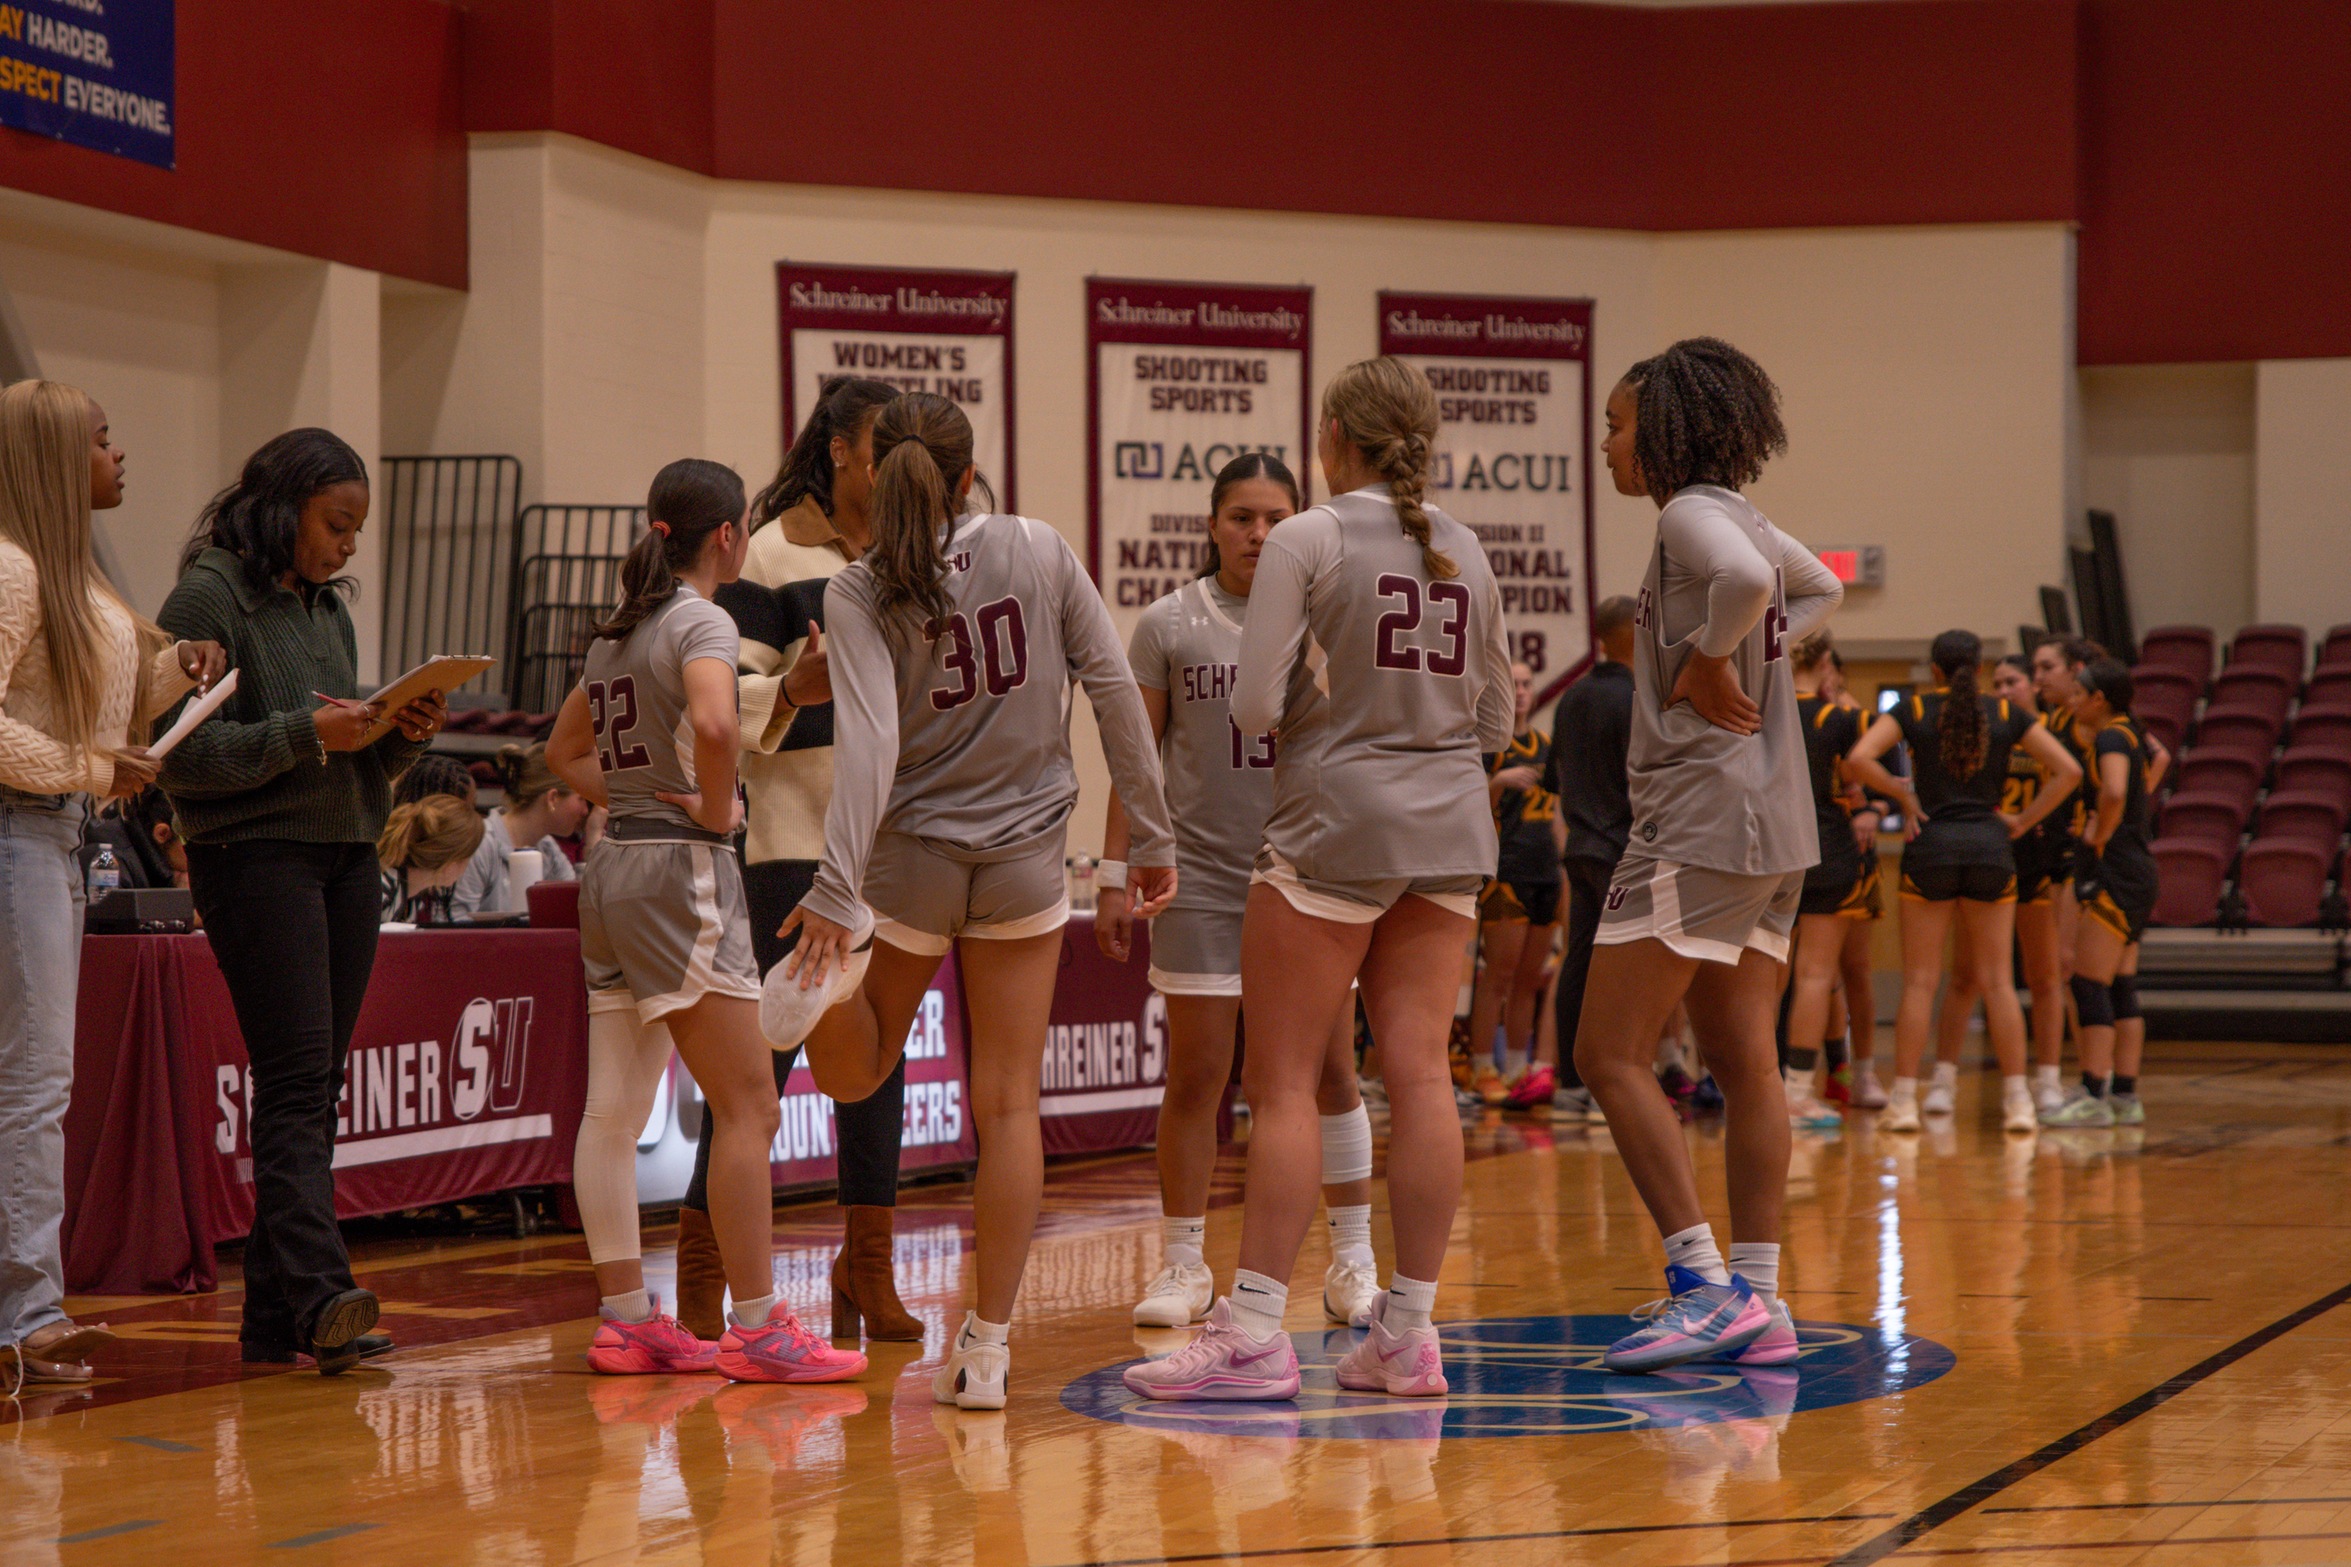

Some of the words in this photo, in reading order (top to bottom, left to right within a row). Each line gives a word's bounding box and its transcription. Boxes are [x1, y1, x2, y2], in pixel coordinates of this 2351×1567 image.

[27, 11, 113, 69] HARDER.
[64, 74, 171, 136] EVERYONE.
[788, 281, 894, 312] Schreiner
[896, 286, 1008, 329] University
[1096, 297, 1196, 326] Schreiner
[1197, 302, 1304, 340] University
[1386, 309, 1483, 338] Schreiner
[1484, 314, 1585, 351] University
[833, 340, 967, 371] WOMEN'S
[1134, 354, 1268, 384] SHOOTING
[1150, 386, 1253, 414] SPORTS
[1425, 366, 1550, 395] SHOOTING
[1440, 397, 1537, 425] SPORTS
[1460, 453, 1571, 492] ACUI
[1373, 571, 1472, 679] 23
[922, 594, 1030, 713] 30
